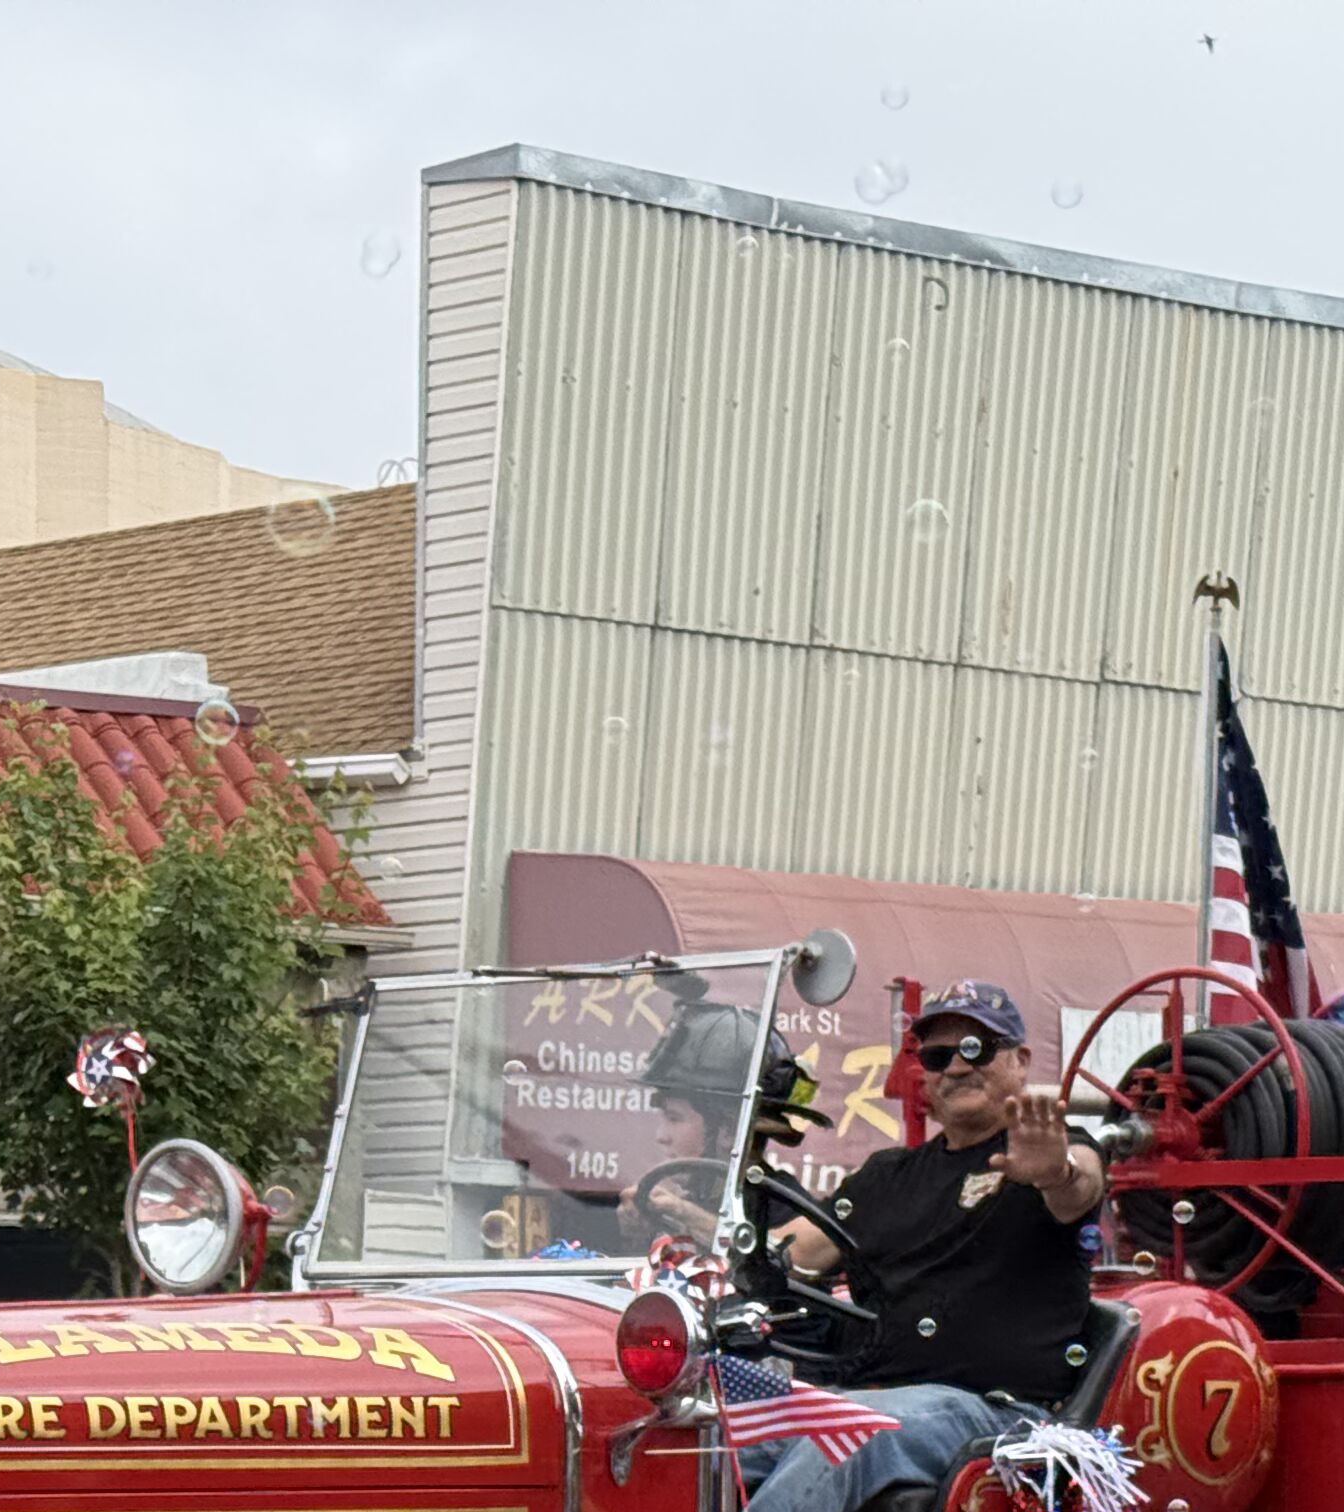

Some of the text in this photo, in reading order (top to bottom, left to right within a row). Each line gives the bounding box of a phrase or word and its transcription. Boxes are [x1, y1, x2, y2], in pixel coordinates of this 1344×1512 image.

[774, 1008, 841, 1036] ark St
[517, 1079, 659, 1112] Restaura
[567, 1151, 620, 1179] 1405
[86, 1394, 460, 1441] DEPARTMENT
[1200, 1379, 1241, 1460] 7
